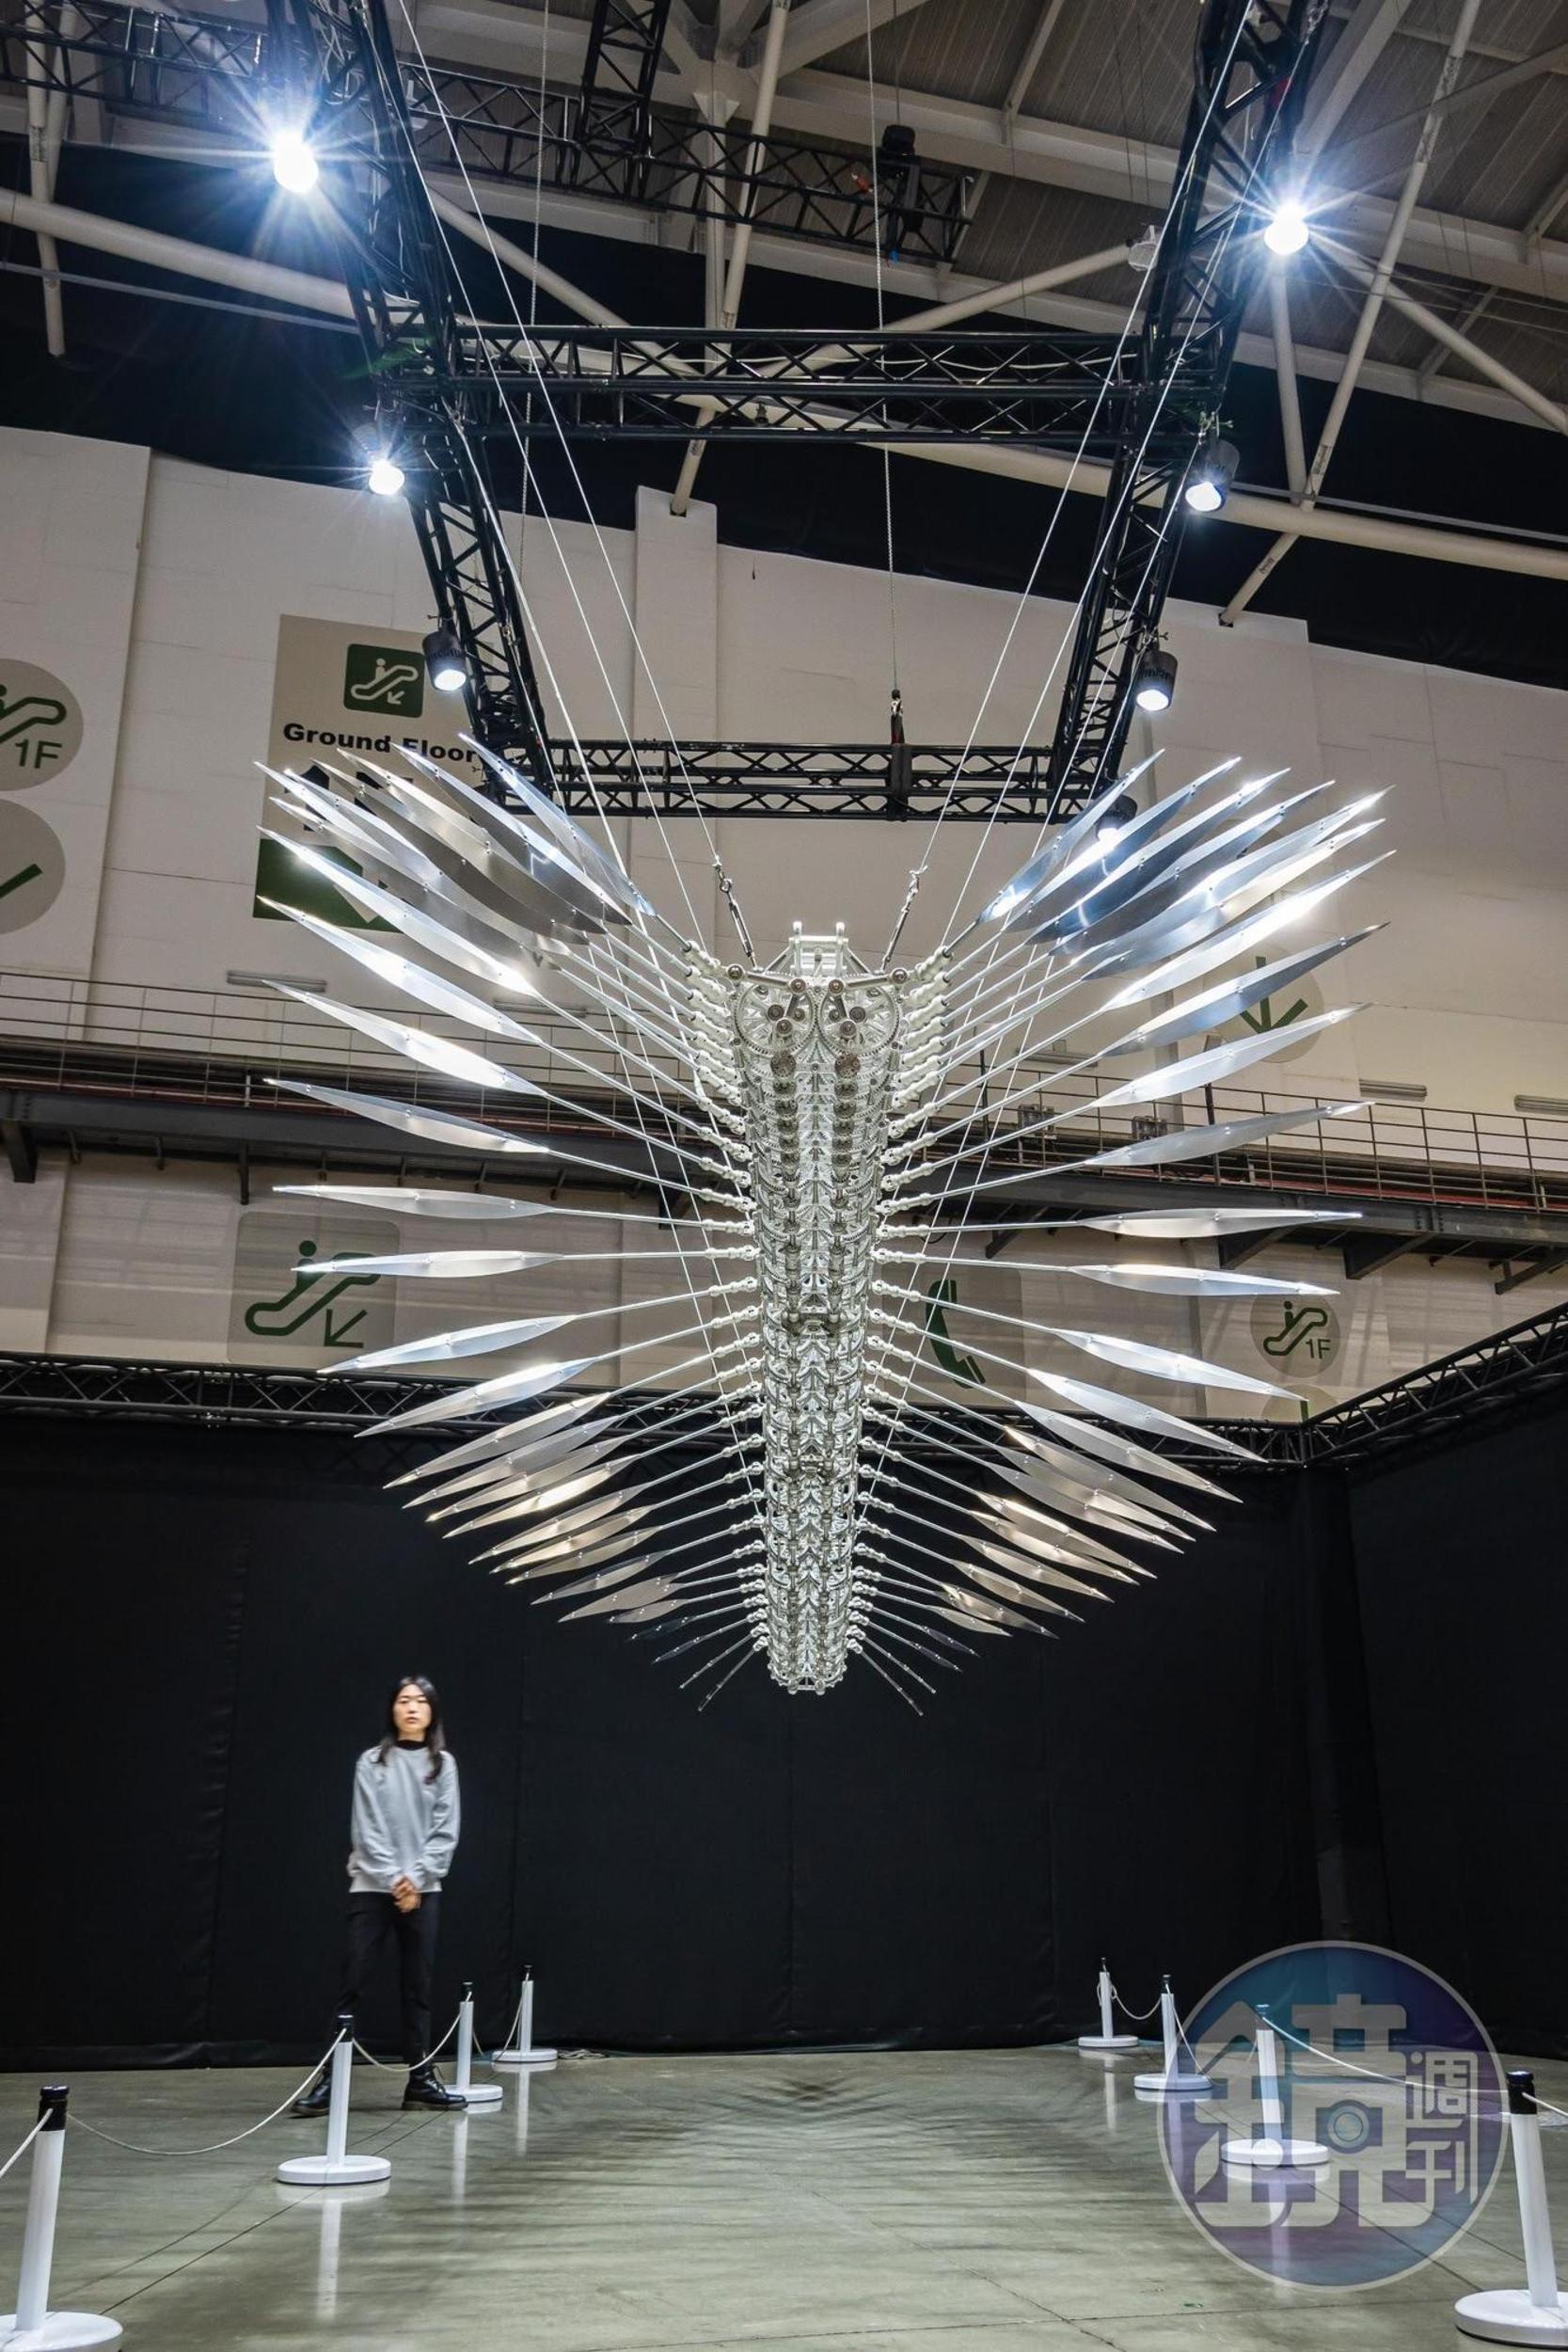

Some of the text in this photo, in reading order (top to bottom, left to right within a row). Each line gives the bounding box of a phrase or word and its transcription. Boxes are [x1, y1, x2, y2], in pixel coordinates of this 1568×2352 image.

[15, 739, 62, 769] 1F
[283, 723, 478, 763] Ground Floor
[1306, 1339, 1331, 1359] 1F
